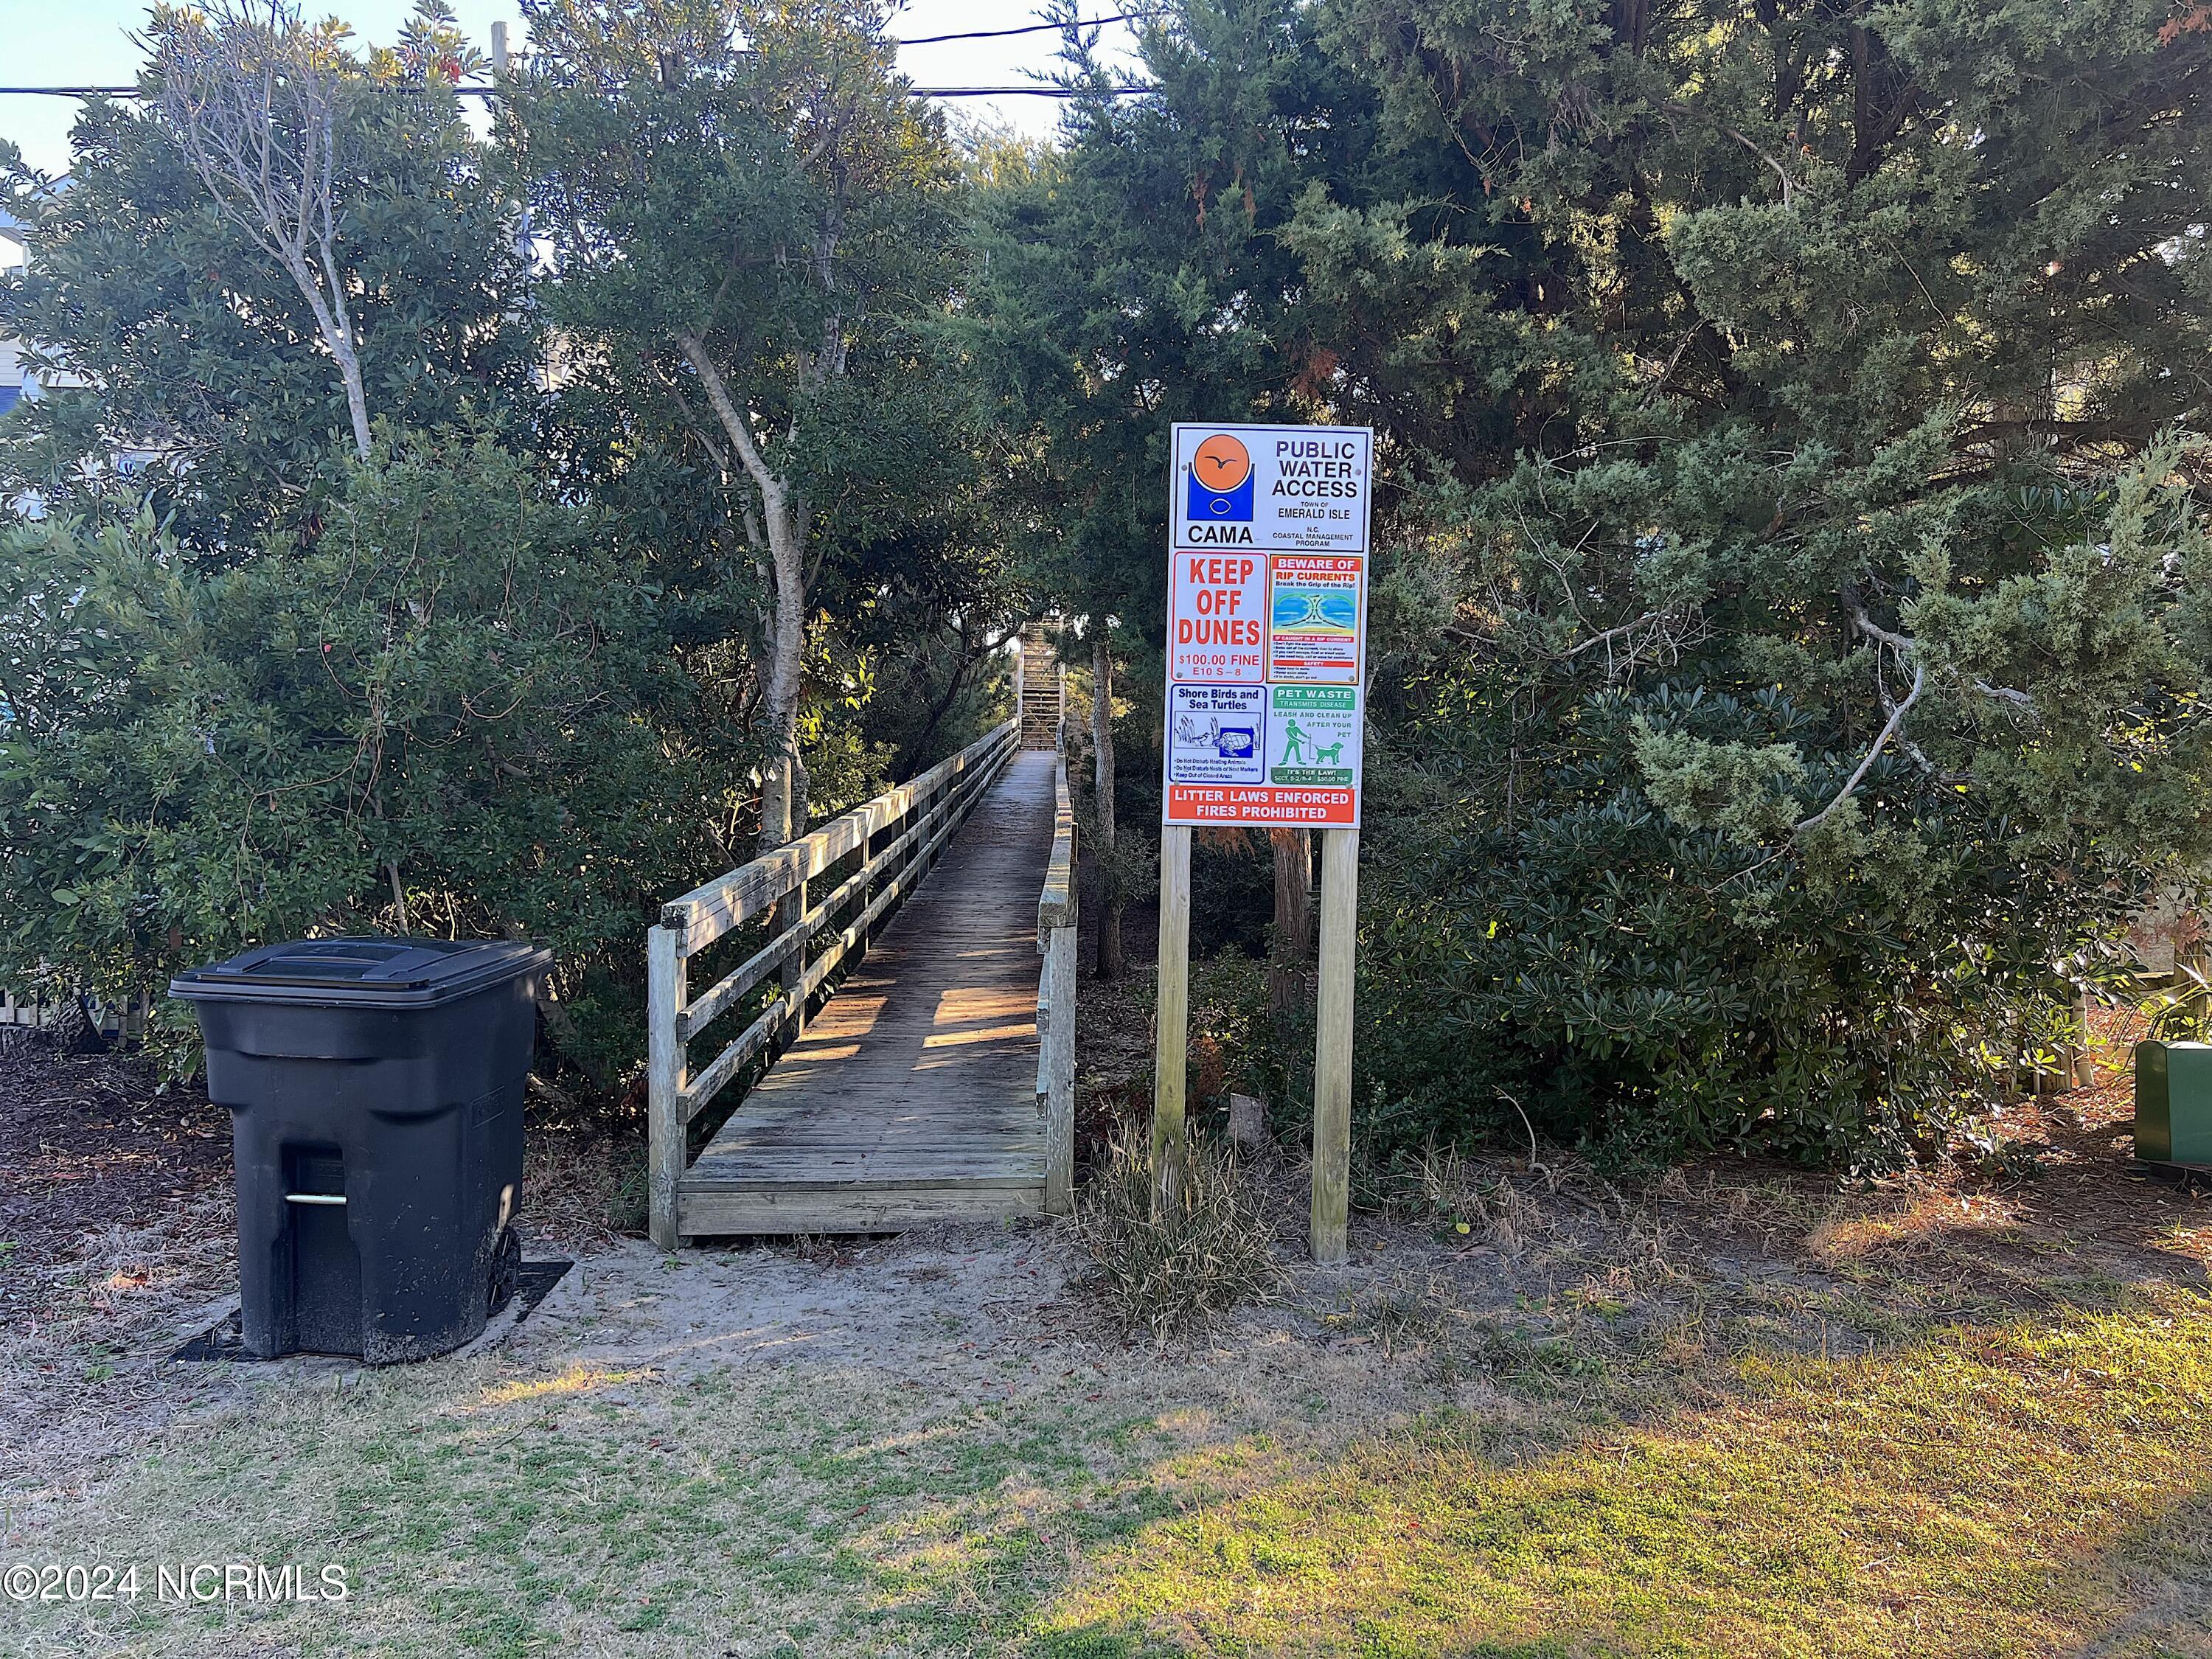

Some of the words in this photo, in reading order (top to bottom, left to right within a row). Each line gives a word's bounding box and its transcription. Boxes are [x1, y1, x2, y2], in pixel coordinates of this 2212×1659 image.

[1276, 441, 1355, 459] PUBLIC
[1279, 460, 1352, 479] WATER
[1272, 479, 1357, 498] ACCESS
[1278, 508, 1325, 518] EMERALD
[1329, 509, 1350, 520] ISLE
[1188, 525, 1253, 543] CAMA
[1278, 558, 1334, 569] BEWARE
[1337, 560, 1355, 570] OF
[1189, 558, 1253, 585] KEEP
[1276, 571, 1294, 580] RIP
[1296, 572, 1355, 582] CURRENTS
[1197, 589, 1242, 616] OFF
[1179, 619, 1260, 646] DUNES
[1179, 654, 1226, 665] $100.00
[1231, 655, 1260, 666] FINE
[1193, 667, 1212, 675] E10
[1216, 667, 1223, 675] S
[1234, 668, 1241, 676] 8
[1178, 688, 1208, 698] Shore
[1211, 689, 1237, 699] Birds
[1239, 689, 1259, 699] and
[1277, 689, 1303, 698] PET
[1306, 690, 1352, 699] WASTE
[1189, 699, 1208, 709] Sea
[1211, 700, 1247, 710] Turtles
[1175, 790, 1224, 801] LITTER
[1230, 790, 1269, 803] LAWS
[1275, 792, 1349, 804] ENFORCED
[1196, 805, 1237, 816] FIRES
[1242, 806, 1326, 819] PROHIBITED
